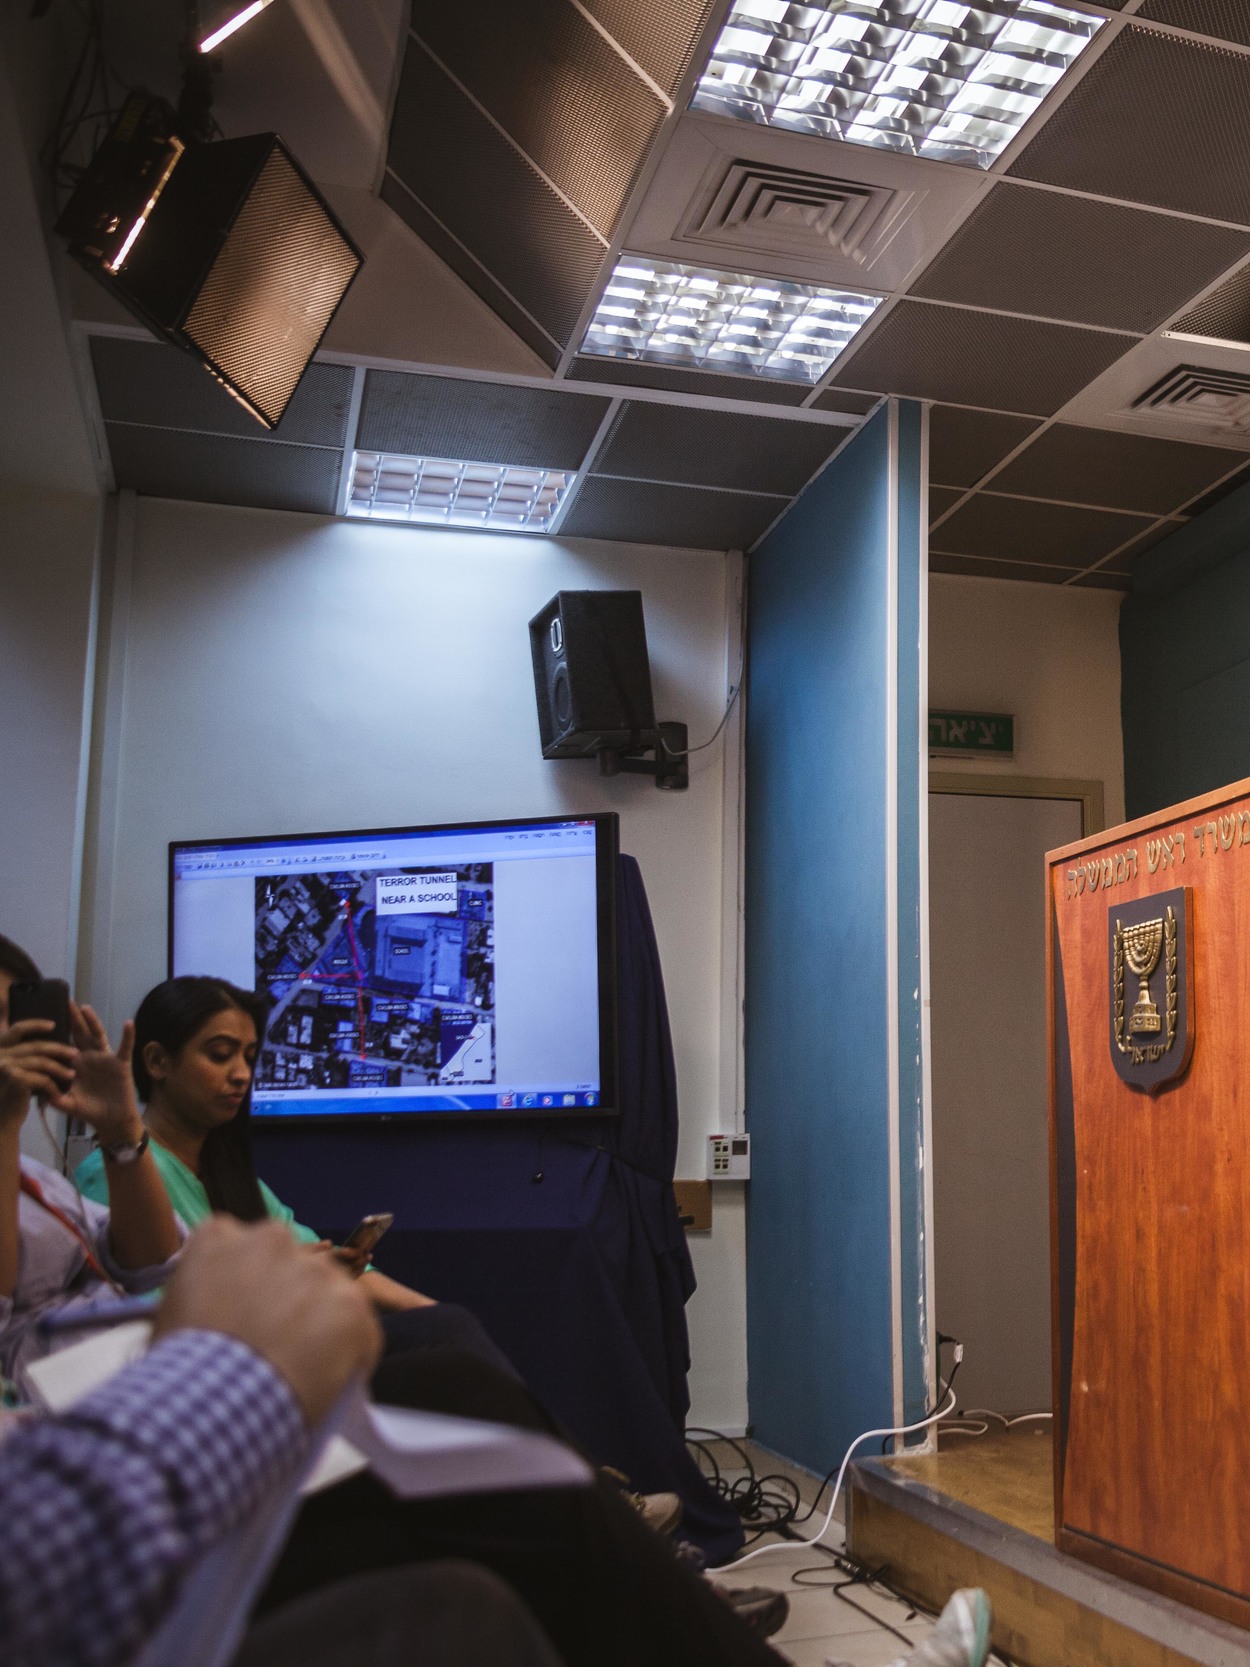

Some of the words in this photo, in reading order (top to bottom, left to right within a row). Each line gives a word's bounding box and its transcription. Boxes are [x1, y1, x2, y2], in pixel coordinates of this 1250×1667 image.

[1145, 832, 1185, 875] ראש
[380, 877, 417, 887] TERROR
[420, 875, 457, 885] TUNNEL
[1066, 848, 1138, 900] הממשלה
[381, 895, 407, 904] NEAR
[409, 895, 415, 903] A
[418, 893, 458, 902] SCHOOL
